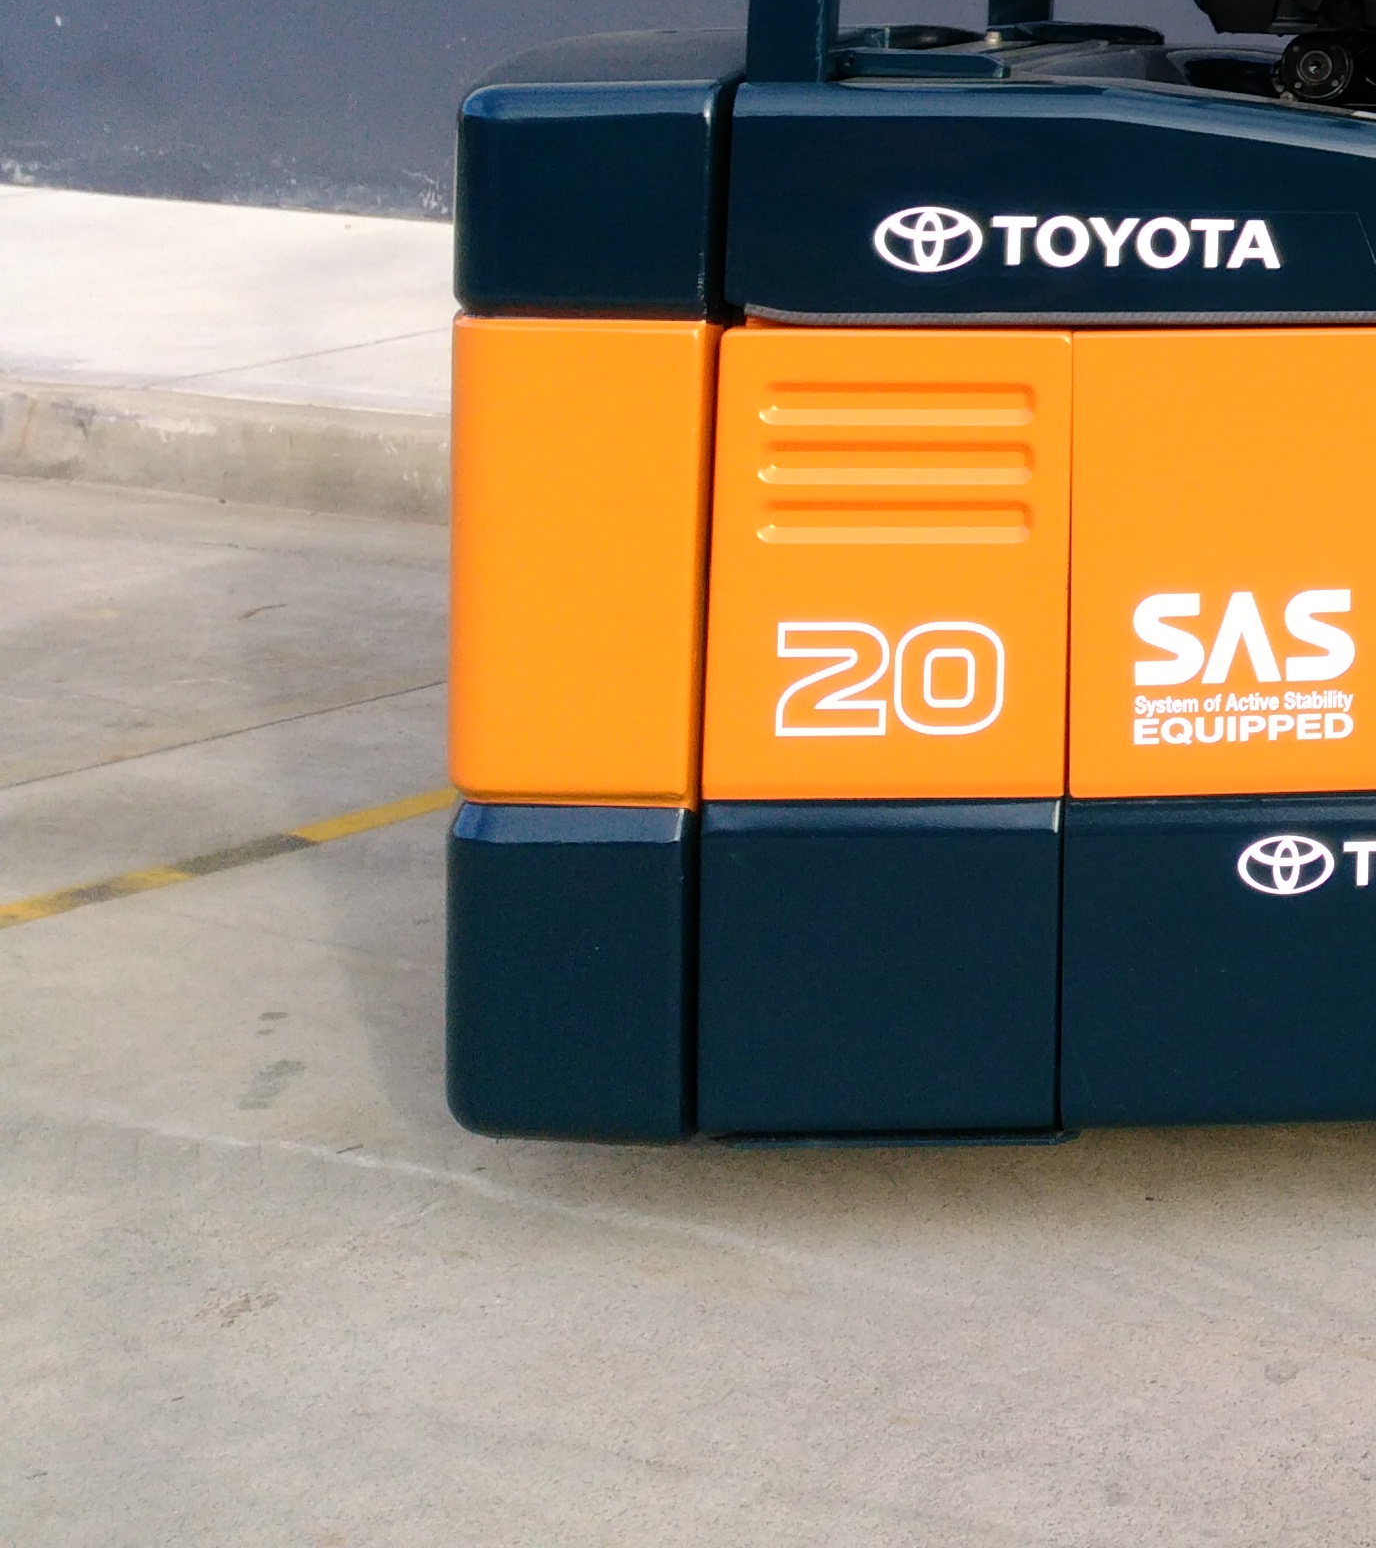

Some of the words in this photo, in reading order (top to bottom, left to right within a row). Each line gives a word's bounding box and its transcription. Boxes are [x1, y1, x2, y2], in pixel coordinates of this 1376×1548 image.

[990, 214, 1282, 271] TOYOTA
[1132, 588, 1357, 687] SAS
[775, 620, 1006, 737] 20
[1134, 695, 1199, 718] System
[1203, 693, 1223, 713] of
[1225, 692, 1280, 712] Active
[1283, 690, 1354, 712] Stability
[1133, 712, 1355, 746] EQUIPPED
